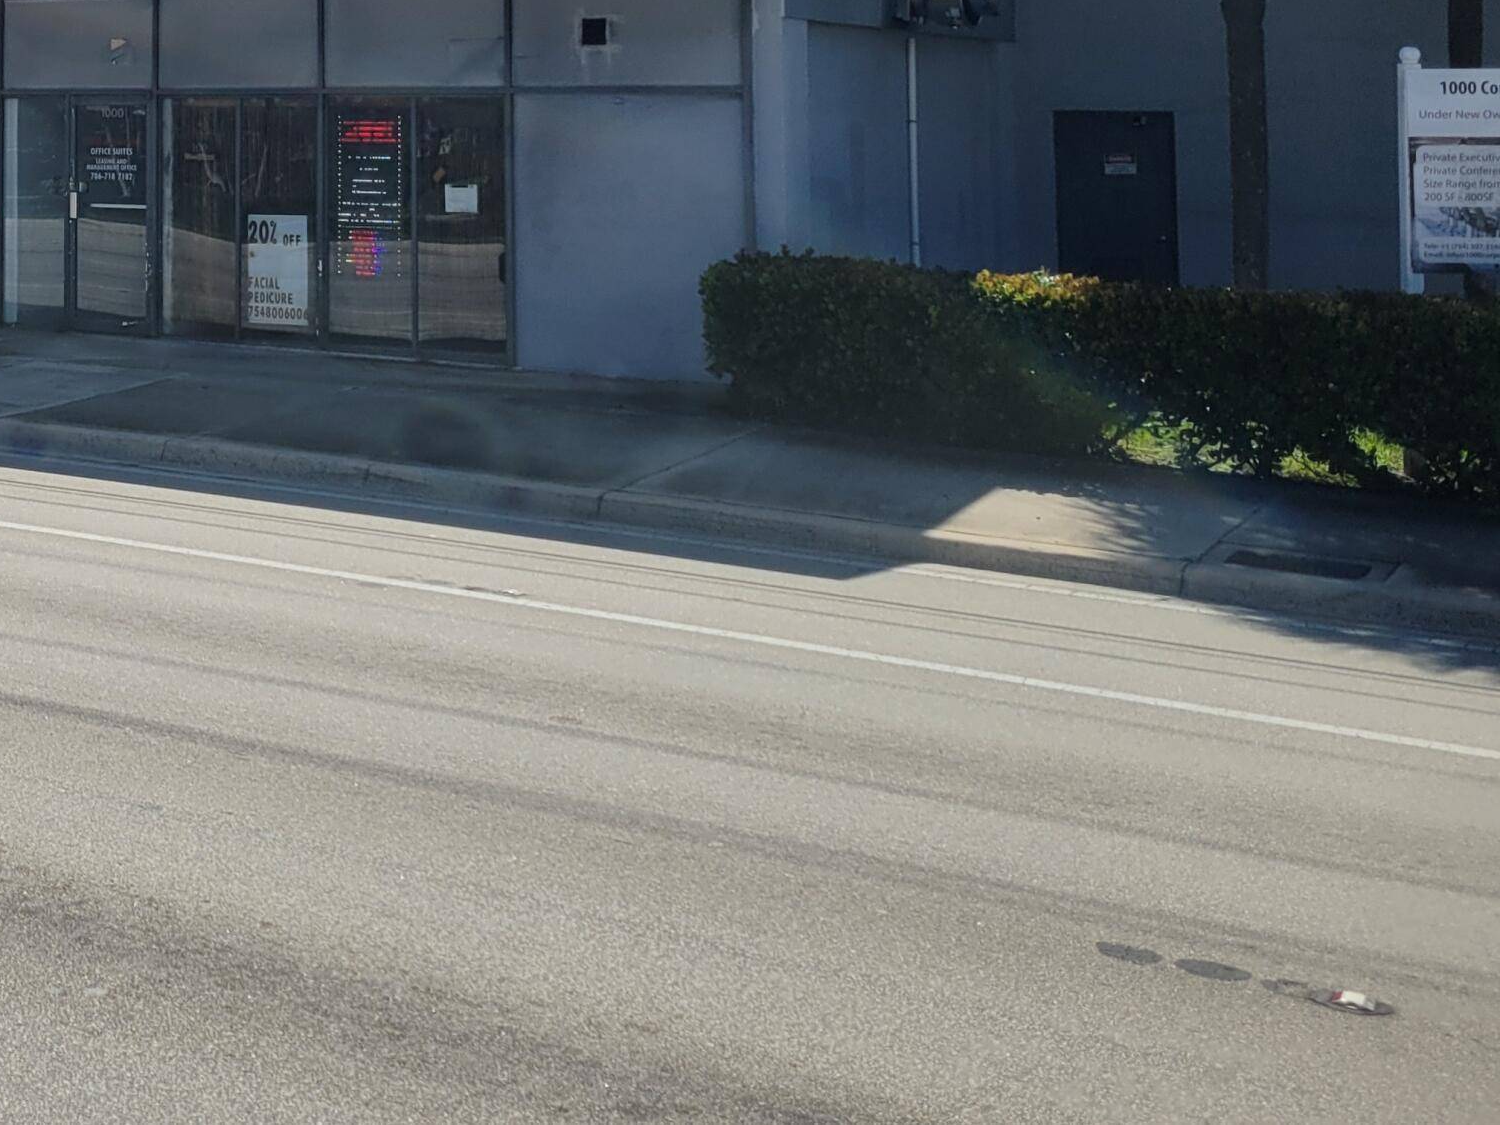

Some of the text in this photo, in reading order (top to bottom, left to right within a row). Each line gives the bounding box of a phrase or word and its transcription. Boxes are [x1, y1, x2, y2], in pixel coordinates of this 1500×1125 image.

[1440, 80, 1500, 95] 1000 Co
[102, 107, 125, 118] 1000
[1419, 109, 1452, 120] Under
[1456, 109, 1480, 120] New
[90, 147, 133, 156] OFFICE SUITES
[1423, 152, 1457, 163] Private
[1423, 166, 1500, 175] Private Confere
[1423, 179, 1443, 188] Size
[1446, 179, 1477, 190] Range
[1424, 192, 1443, 202] 200
[248, 220, 302, 247] 20% OFF
[248, 277, 280, 290] FACIAL
[248, 291, 294, 305] PEDICURE
